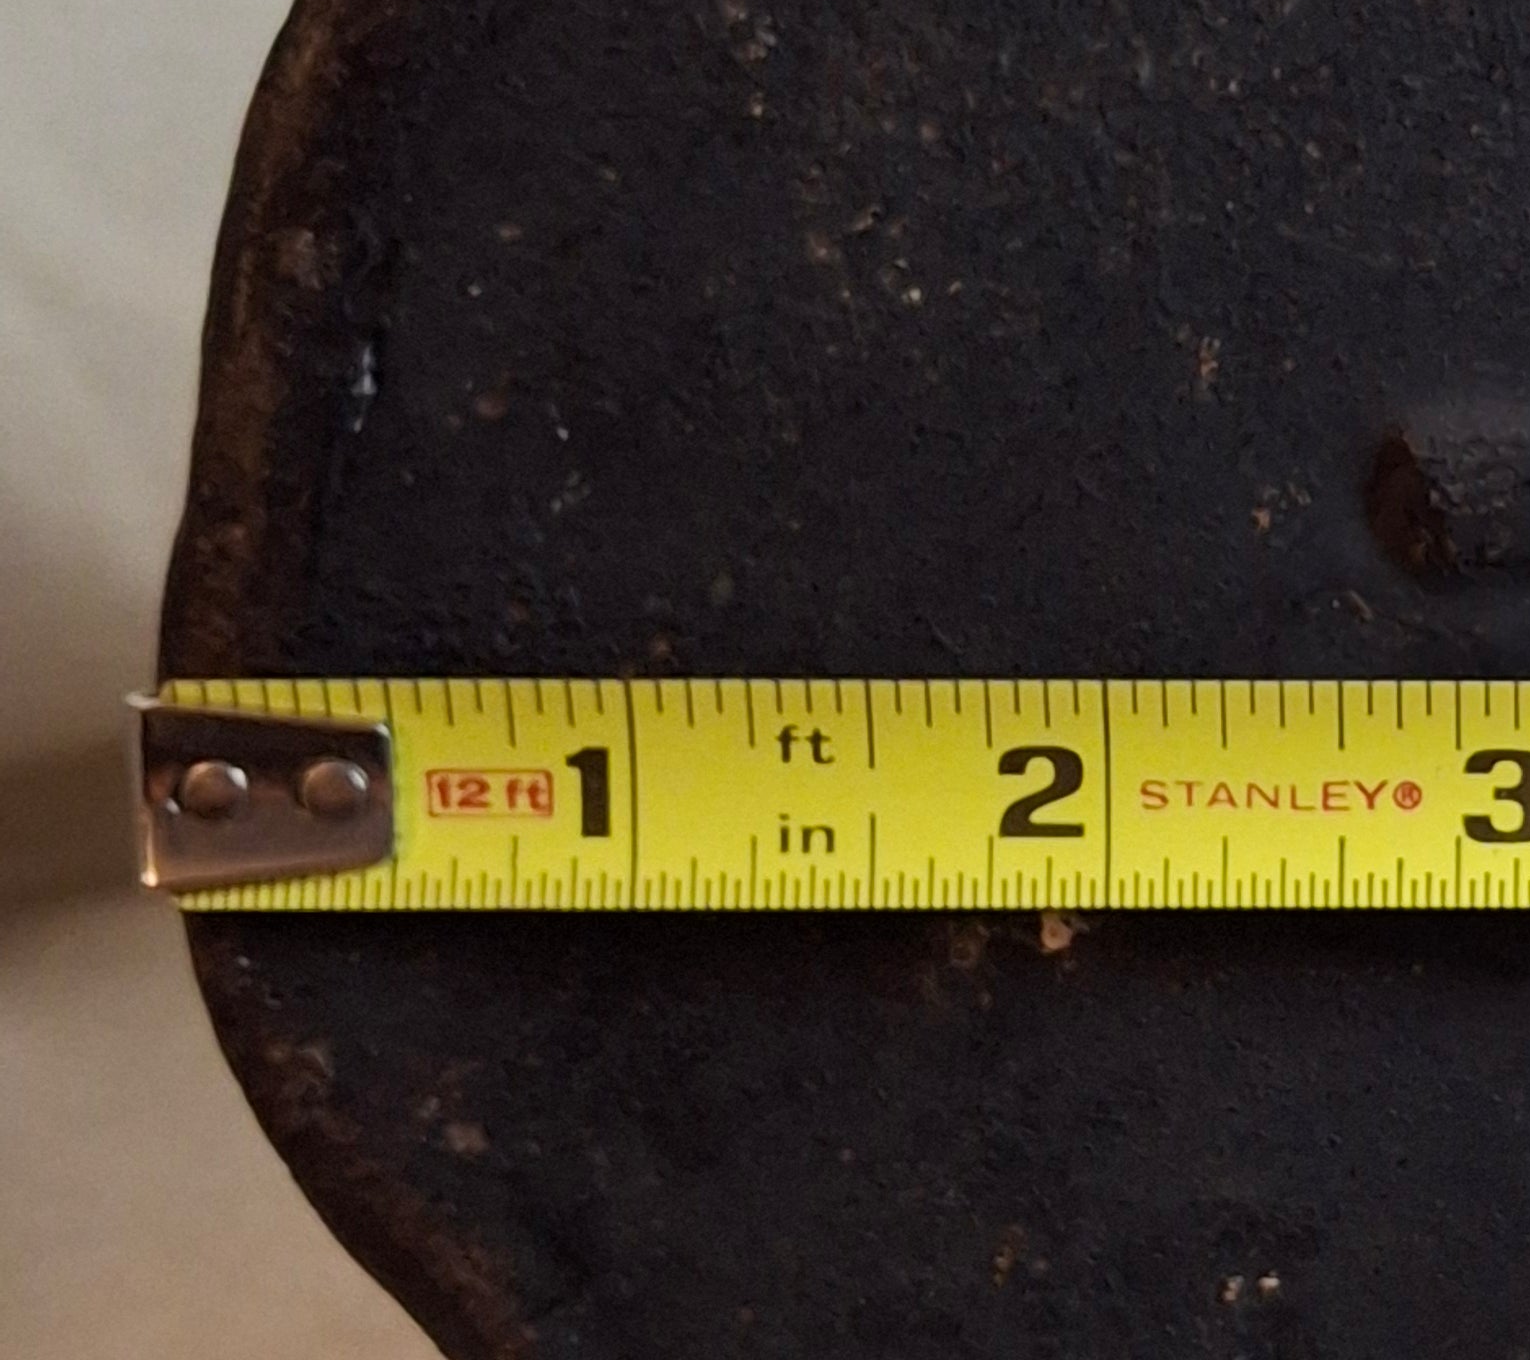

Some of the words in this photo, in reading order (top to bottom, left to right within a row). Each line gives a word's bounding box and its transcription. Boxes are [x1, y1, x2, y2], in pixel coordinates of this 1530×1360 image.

[778, 725, 835, 764] ft
[434, 776, 491, 810] 12
[505, 774, 549, 811] ft
[565, 747, 610, 837] 1
[997, 745, 1085, 838] 2
[778, 815, 835, 853] in
